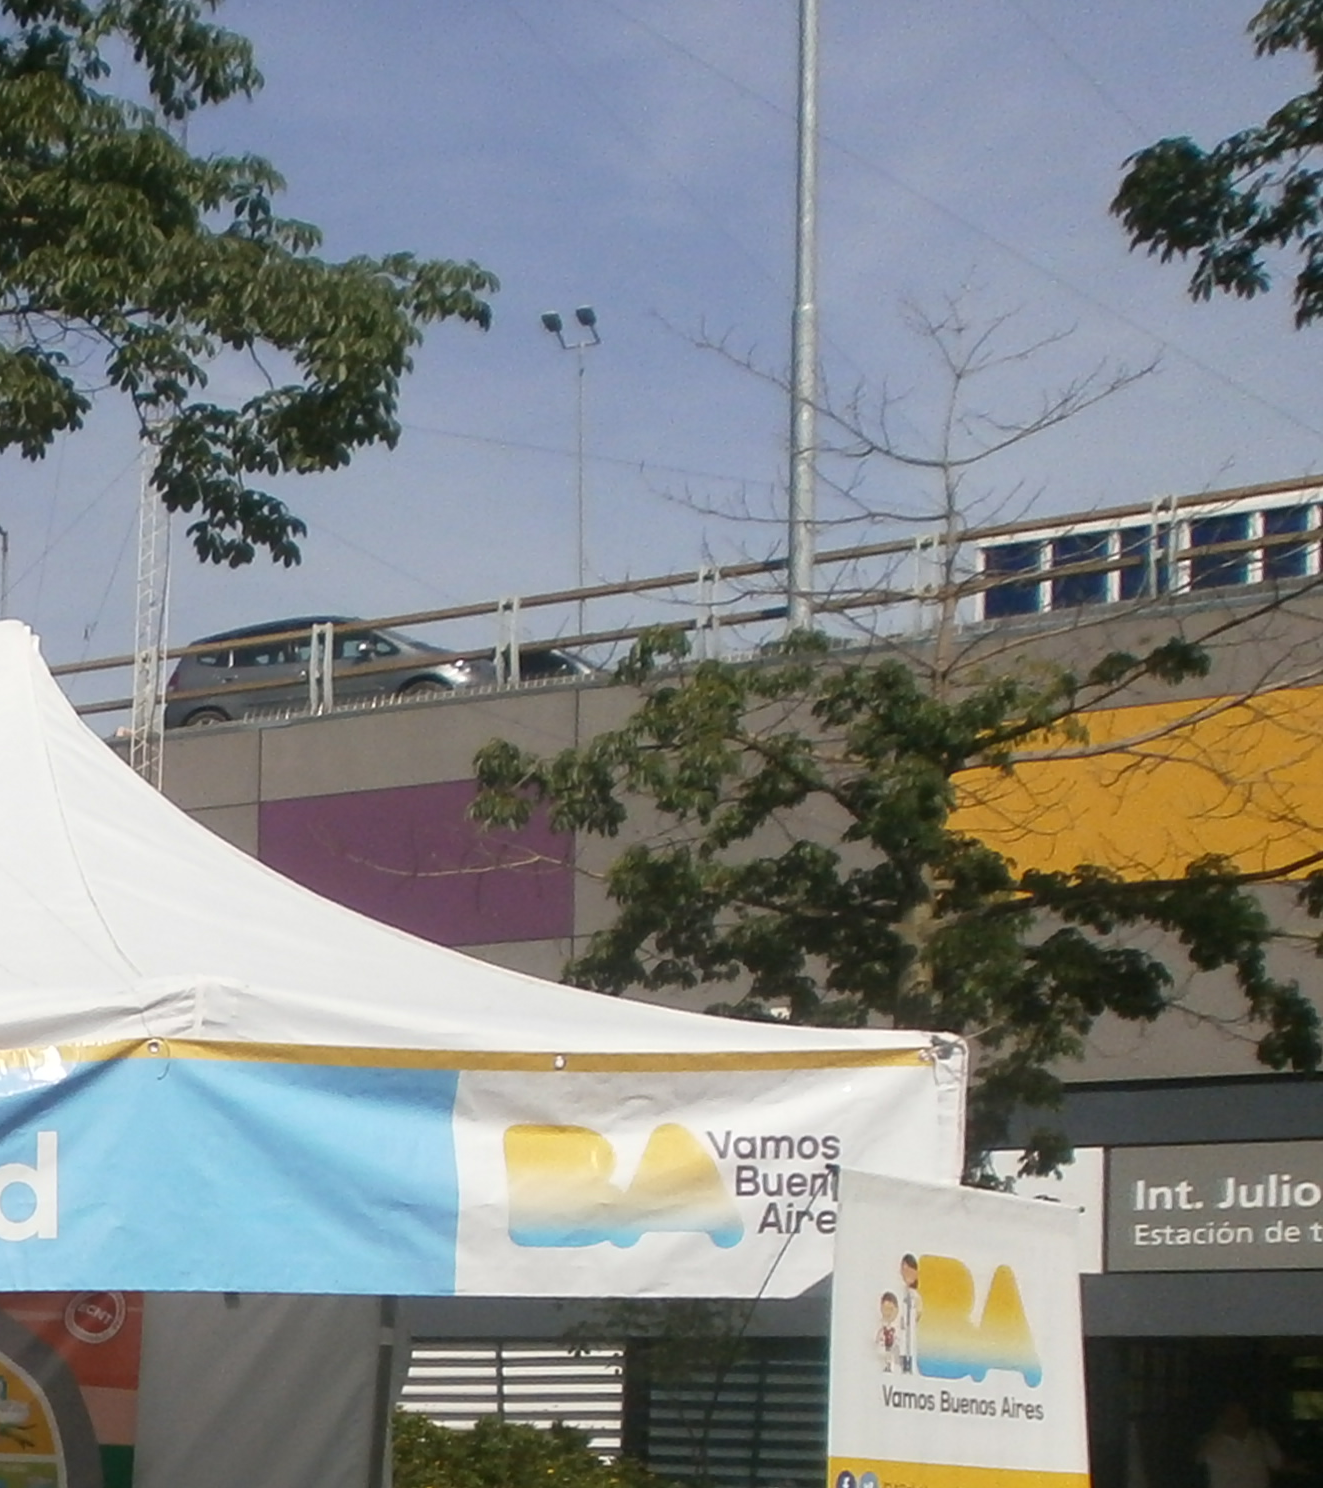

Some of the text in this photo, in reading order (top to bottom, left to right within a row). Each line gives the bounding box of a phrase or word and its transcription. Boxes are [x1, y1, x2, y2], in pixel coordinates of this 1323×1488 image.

[706, 1130, 841, 1159] Vamos
[735, 1165, 829, 1197] Buen
[1133, 1174, 1322, 1211] Int. Julio
[757, 1203, 837, 1234] Aire
[1134, 1221, 1323, 1246] Estación de t
[882, 1384, 1044, 1420] Vamos Buenos Aires
